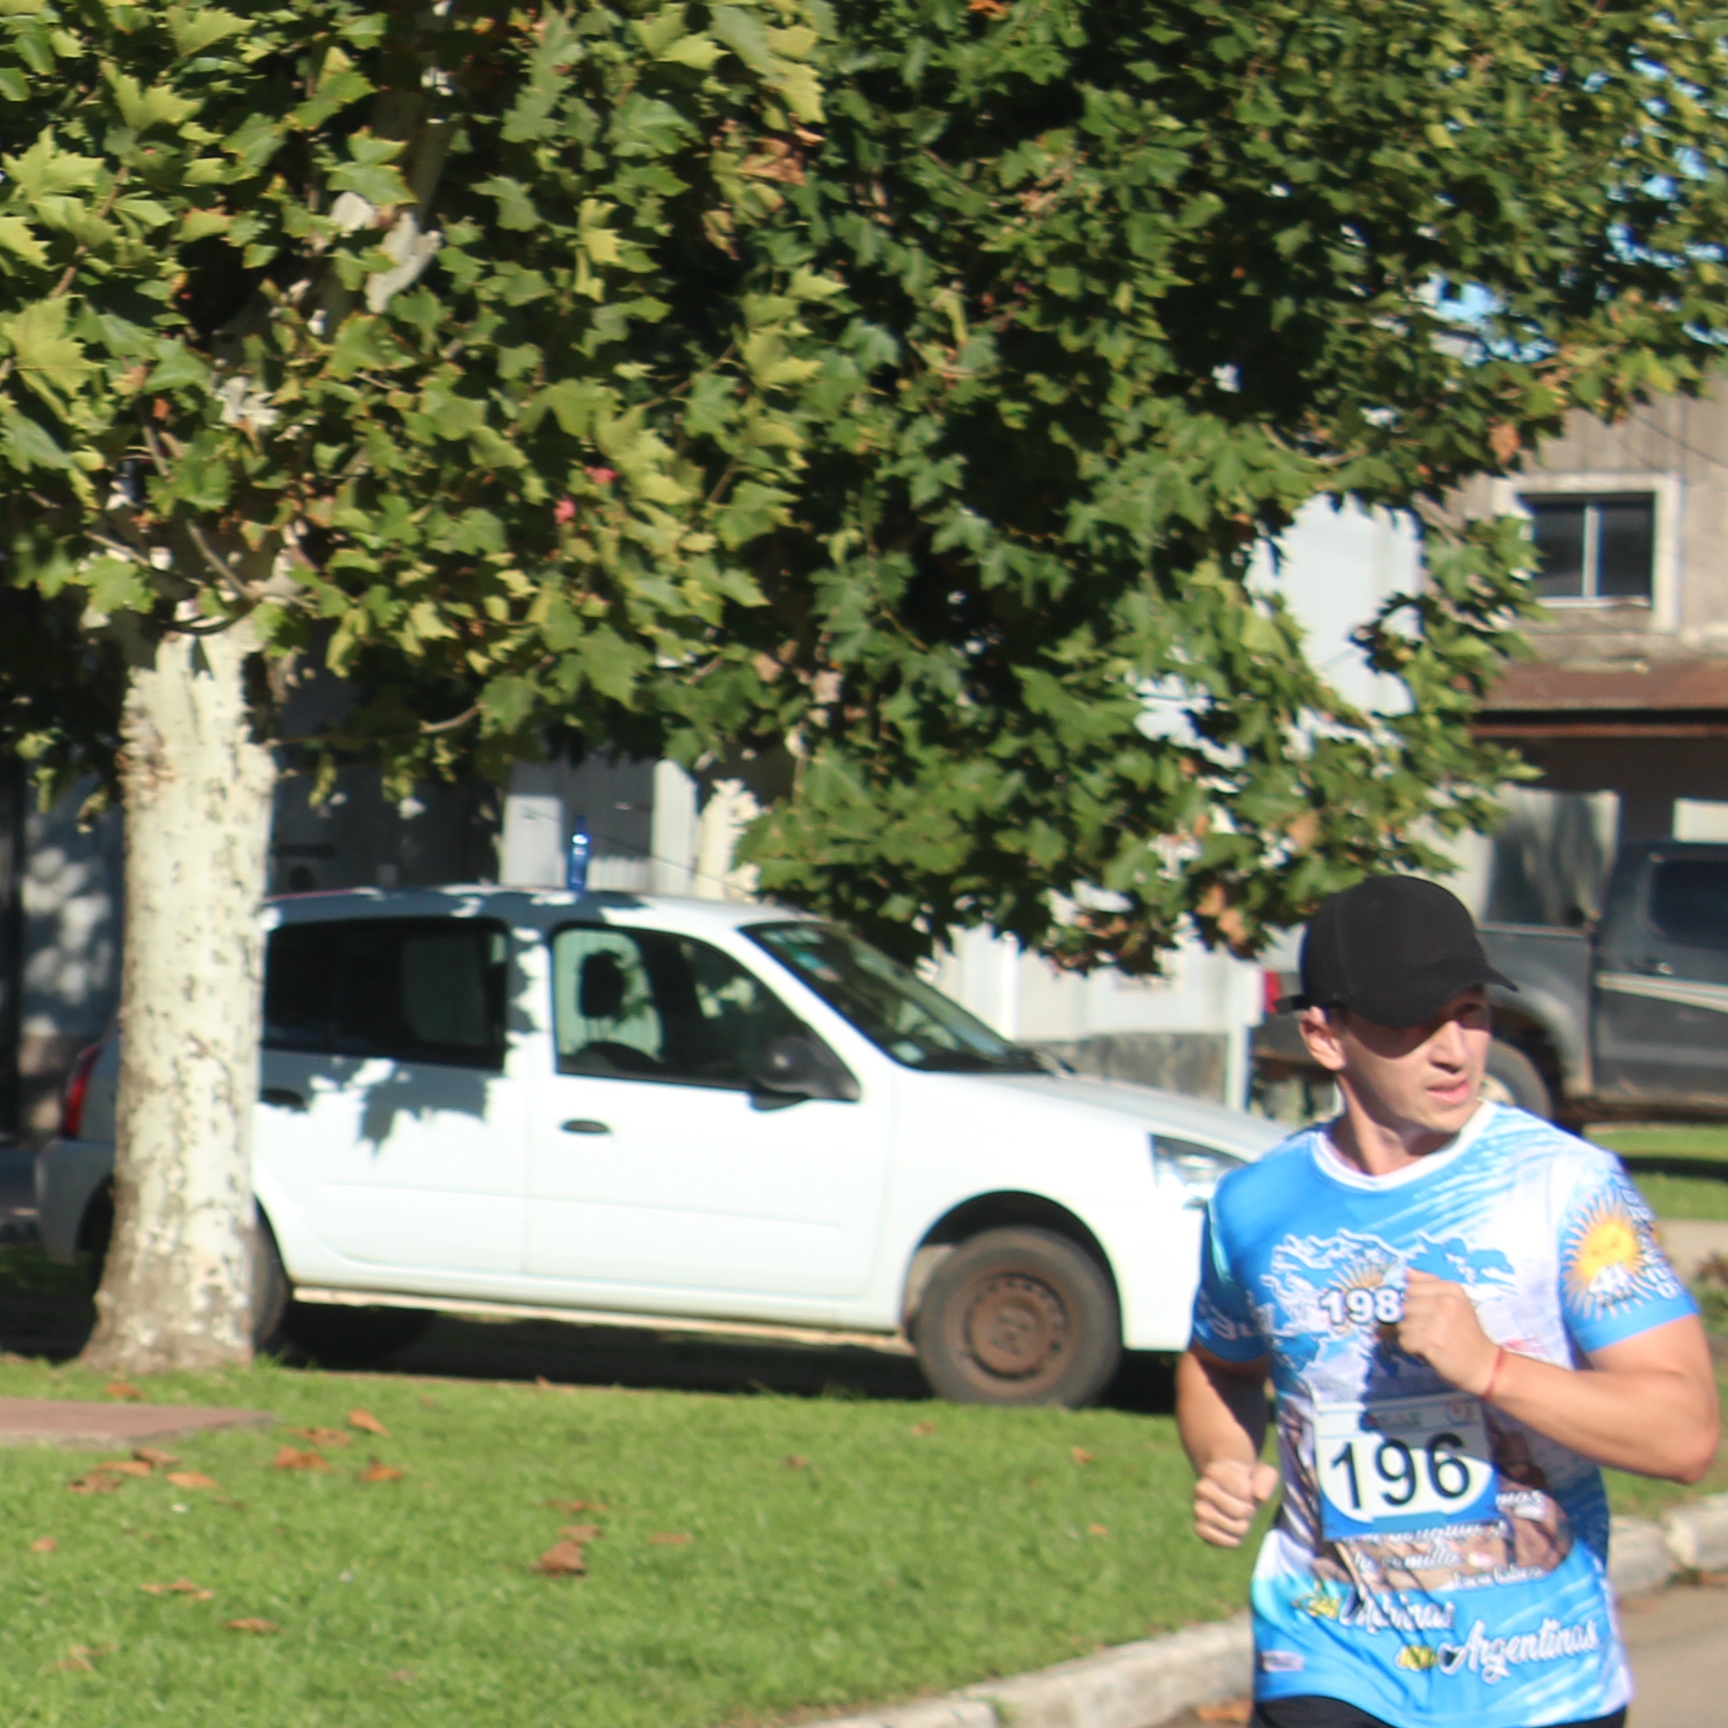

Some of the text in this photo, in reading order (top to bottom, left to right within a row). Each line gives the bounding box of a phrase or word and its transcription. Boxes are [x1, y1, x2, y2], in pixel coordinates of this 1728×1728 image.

[1319, 1286, 1405, 1325] 198
[1331, 1431, 1470, 1509] 196
[1438, 1617, 1601, 1684] Argentinas
